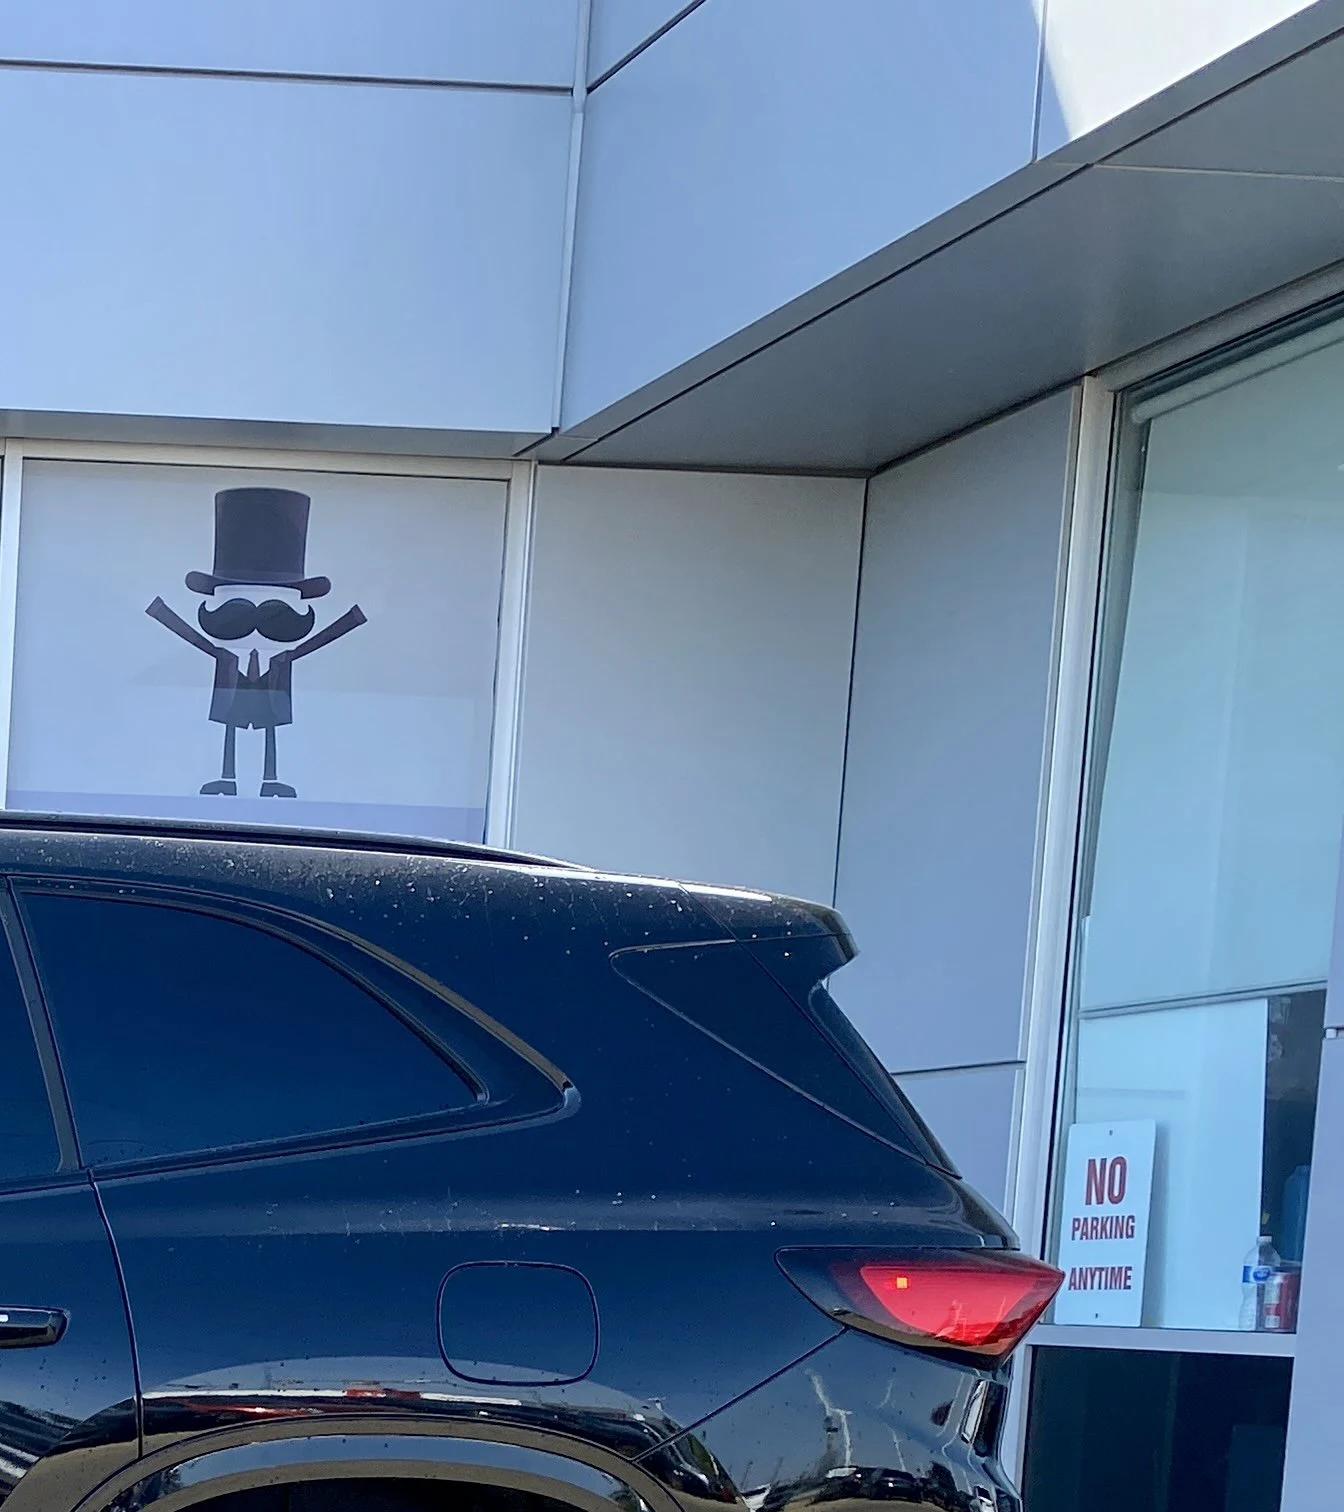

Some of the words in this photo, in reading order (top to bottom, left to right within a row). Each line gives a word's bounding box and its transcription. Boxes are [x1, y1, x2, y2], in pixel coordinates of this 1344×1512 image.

[1084, 1155, 1128, 1206] NO
[1071, 1214, 1136, 1241] PARKING
[1067, 1265, 1133, 1291] ANYTIME
